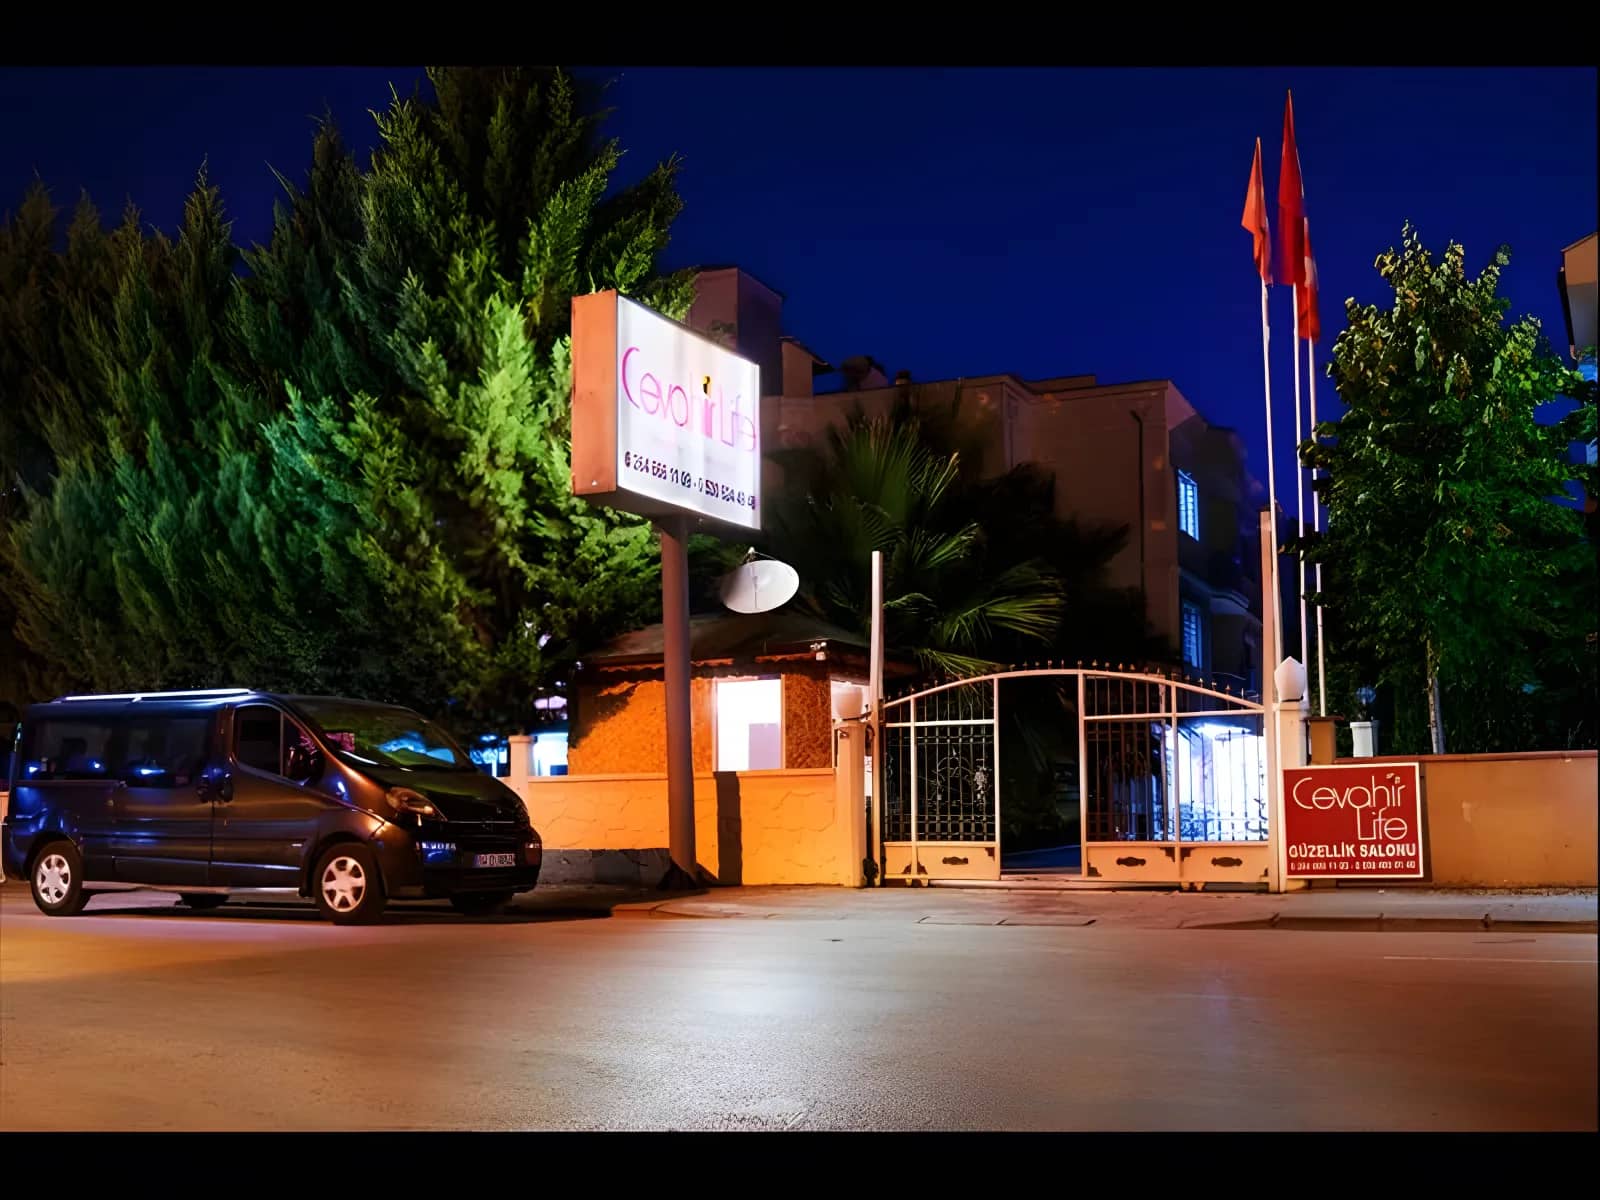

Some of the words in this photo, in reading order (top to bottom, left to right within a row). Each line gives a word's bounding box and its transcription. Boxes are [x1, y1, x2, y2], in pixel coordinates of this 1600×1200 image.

[1293, 775, 1406, 810] Cevahir
[1357, 807, 1408, 840] Life
[1288, 842, 1356, 858] GÜZELLİK
[1360, 843, 1416, 858] SALONU
